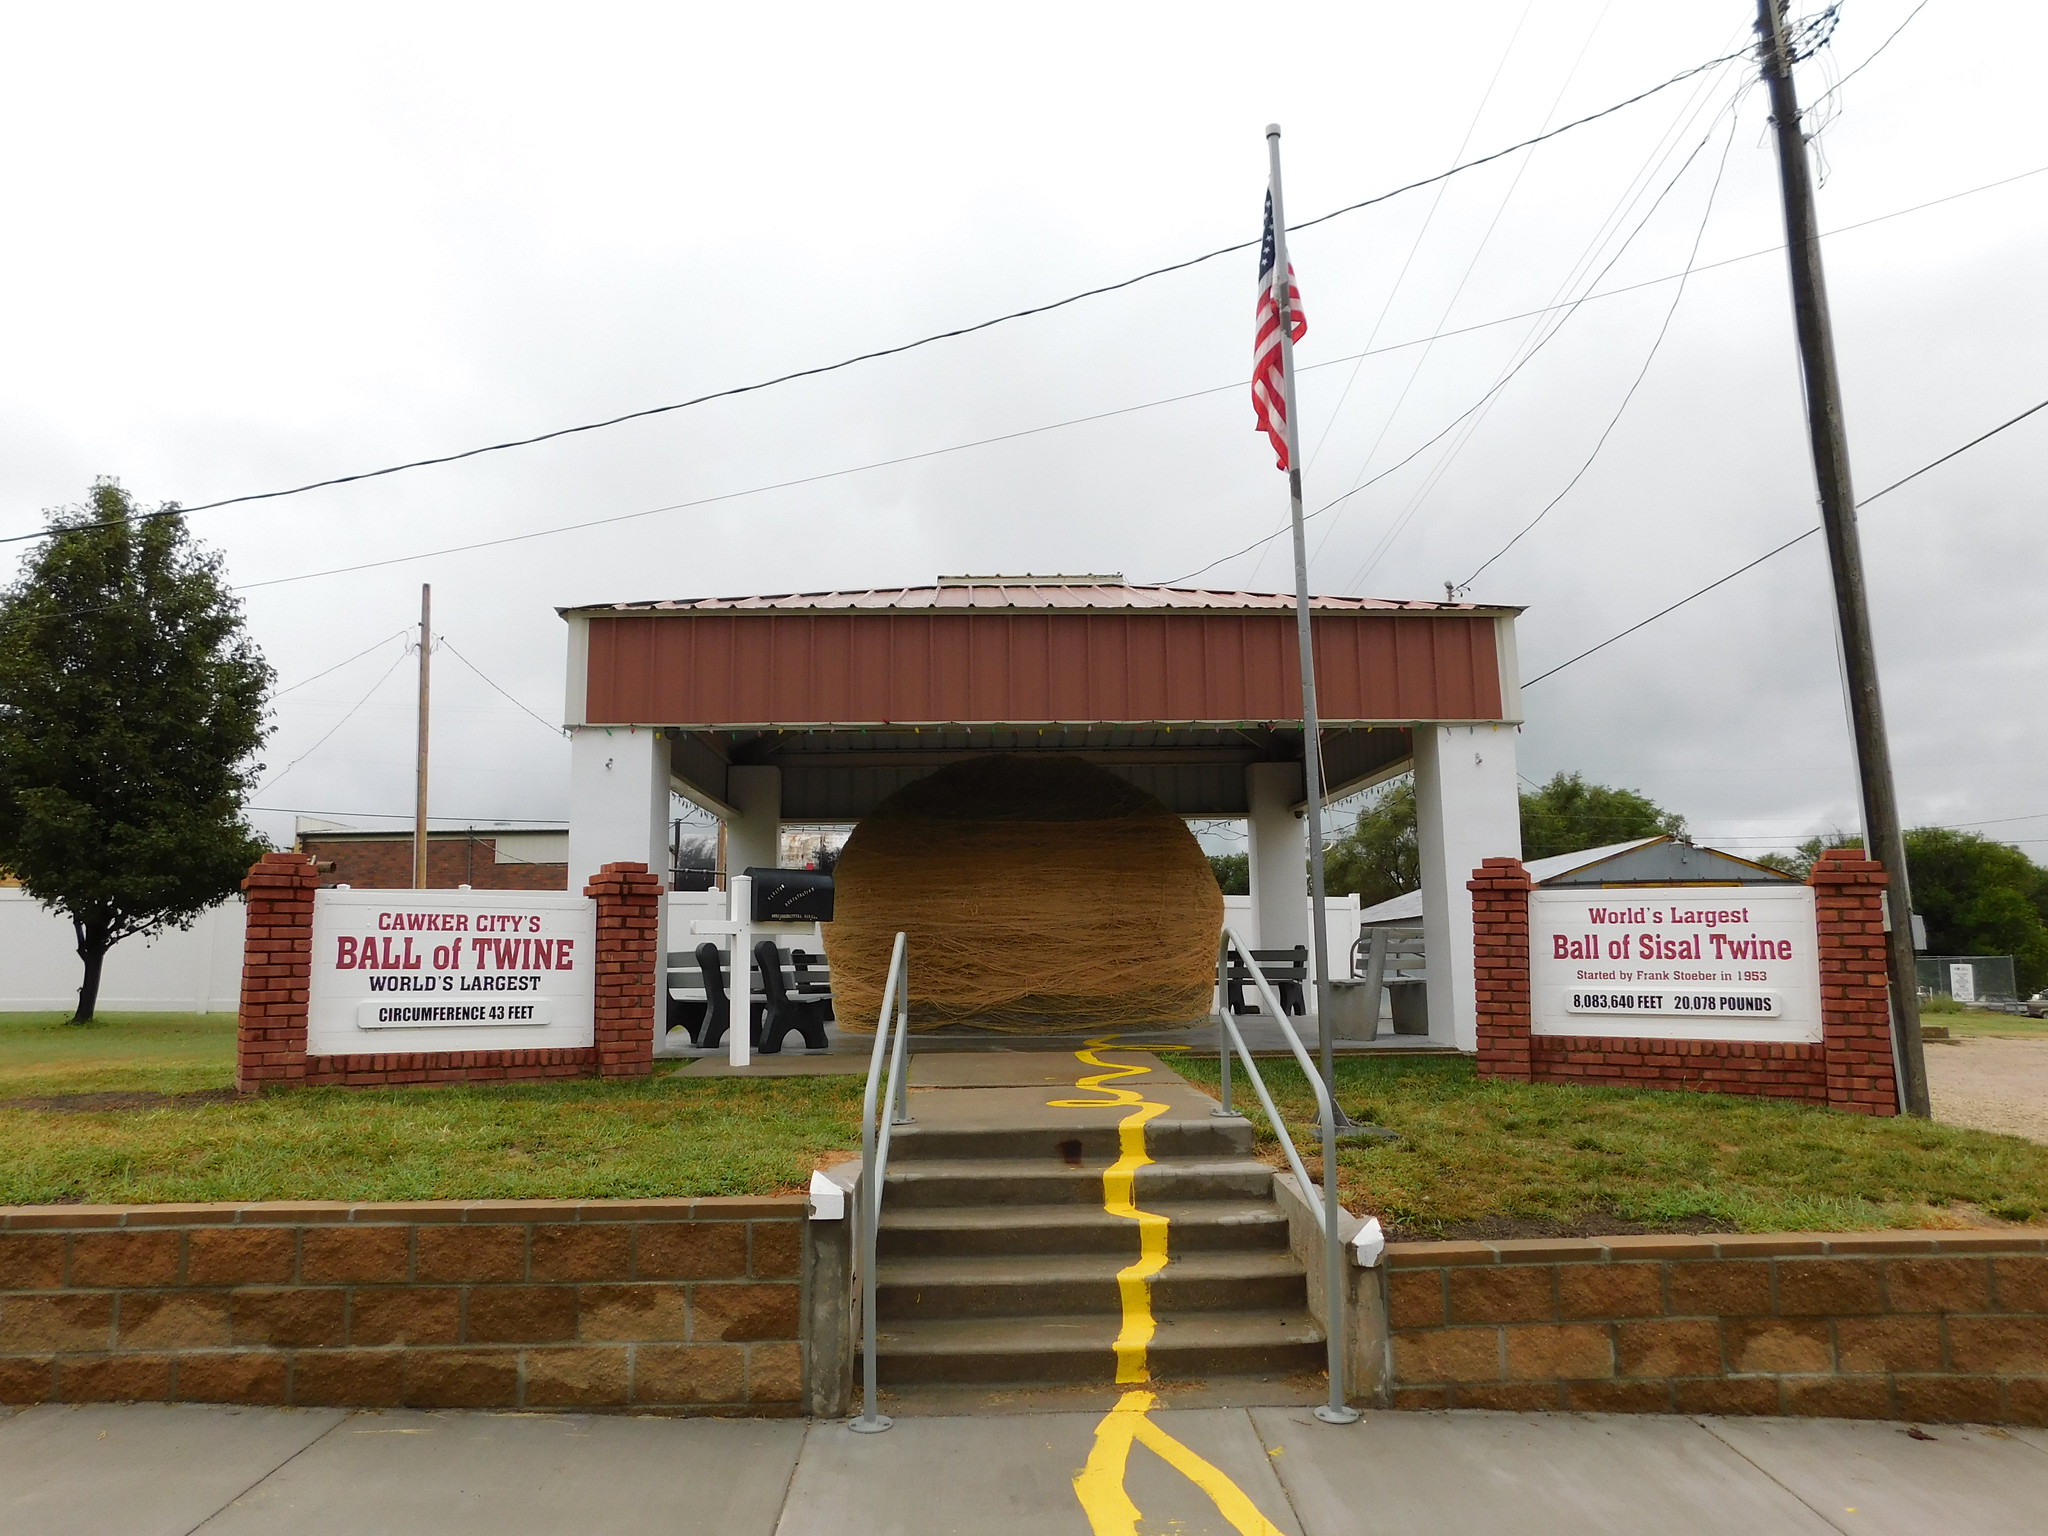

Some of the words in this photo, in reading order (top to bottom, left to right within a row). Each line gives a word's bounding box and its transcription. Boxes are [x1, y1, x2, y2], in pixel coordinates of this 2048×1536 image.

[378, 913, 468, 932] CAWKER
[476, 915, 541, 932] CITY'S
[1588, 908, 1663, 924] World's
[1671, 907, 1749, 927] Largest
[336, 936, 421, 970] BALL
[434, 938, 463, 970] of
[472, 938, 574, 970] TWINE
[1553, 934, 1599, 960] Ball
[1608, 934, 1630, 960] of
[1639, 933, 1701, 960] Sisal
[1709, 934, 1792, 960] Twine
[369, 976, 454, 992] WORLD'S
[460, 976, 541, 991] LARGEST
[1577, 970, 1616, 980] Started
[1620, 970, 1633, 982] by
[1637, 971, 1670, 980] Frank
[1674, 971, 1717, 981] Stoeber
[1721, 971, 1732, 981] in
[1737, 971, 1767, 981] 1953
[1573, 995, 1634, 1011] 8,083,640
[1638, 996, 1663, 1009] FEET
[1674, 996, 1716, 1011] 20,078
[1720, 997, 1772, 1011] POUNDS
[379, 1006, 486, 1022] CIRCUMFERENCE
[489, 1006, 505, 1020] 43
[508, 1006, 534, 1019] FEET
